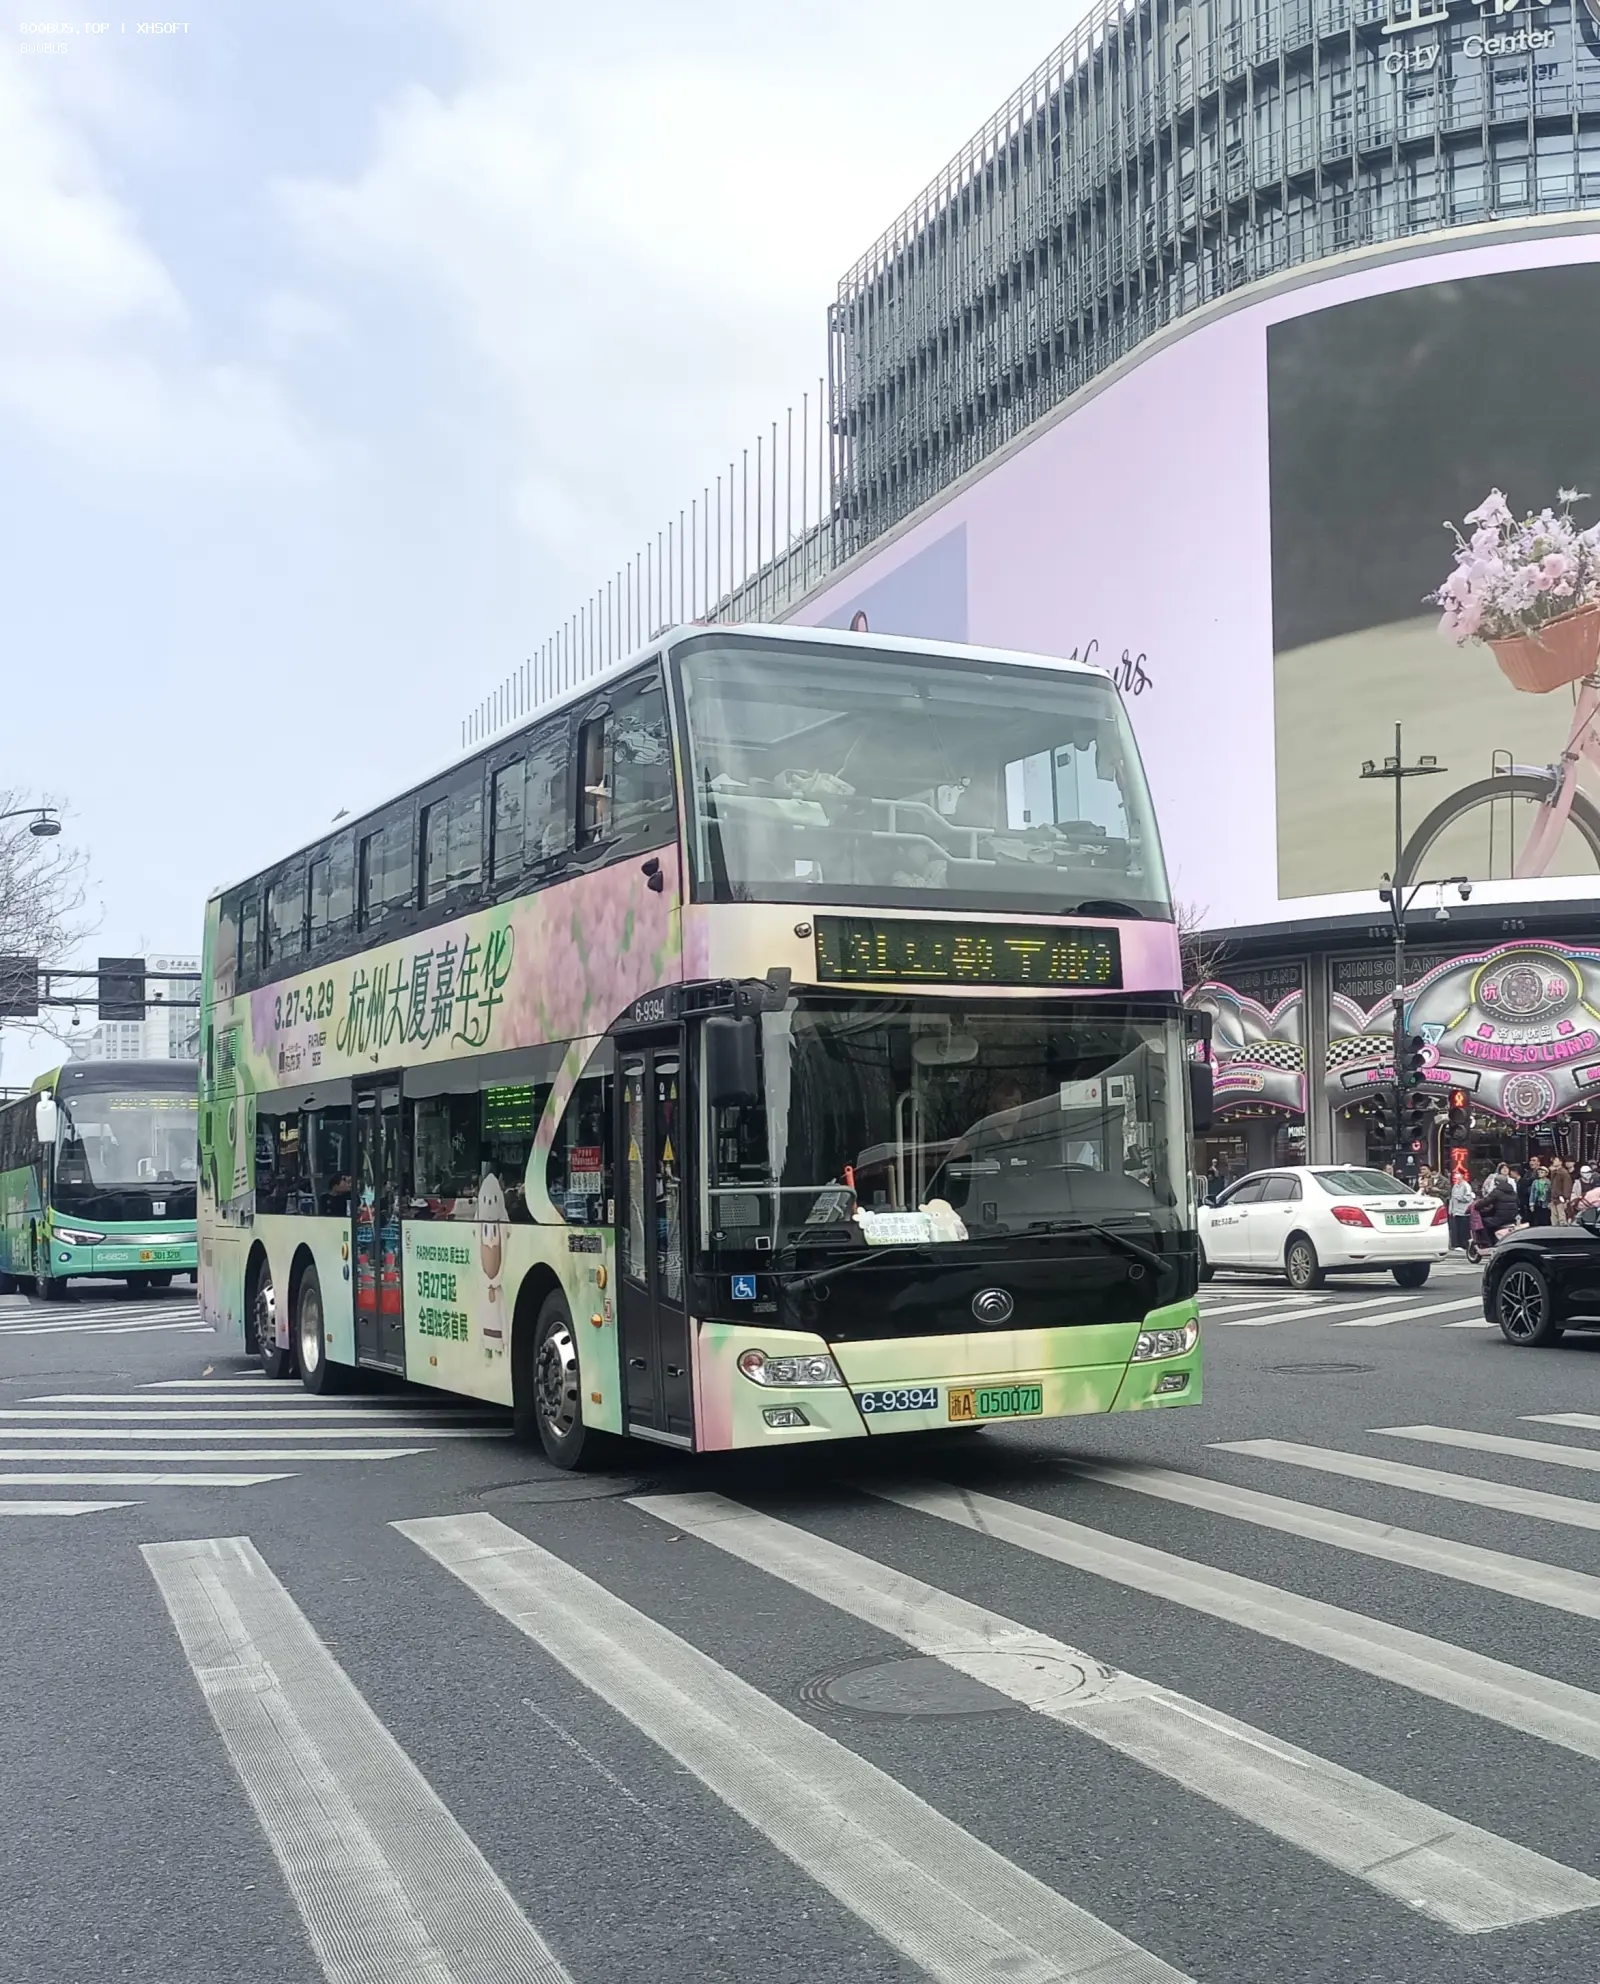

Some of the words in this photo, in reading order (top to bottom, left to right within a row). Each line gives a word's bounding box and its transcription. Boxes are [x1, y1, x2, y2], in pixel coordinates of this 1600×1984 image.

[1384, 44, 1440, 75] City
[1463, 28, 1555, 58] Center
[1263, 968, 1300, 986] LAND
[1338, 959, 1396, 979] MINISO
[336, 924, 515, 1058] 杭州大厦嘉年华
[1483, 983, 1499, 1001] 杭
[1547, 979, 1566, 996] 州
[274, 979, 334, 1031] 3.27-3.29
[635, 999, 665, 1022] 6-9394
[1498, 1025, 1552, 1040] 名创优品
[1463, 1037, 1538, 1063] MINISO
[1542, 1031, 1597, 1061] LAND
[1418, 1067, 1451, 1084] AND
[417, 1270, 457, 1303] 3月27日起
[418, 1305, 469, 1342] 全国独家首展
[861, 1387, 937, 1414] 6-9394
